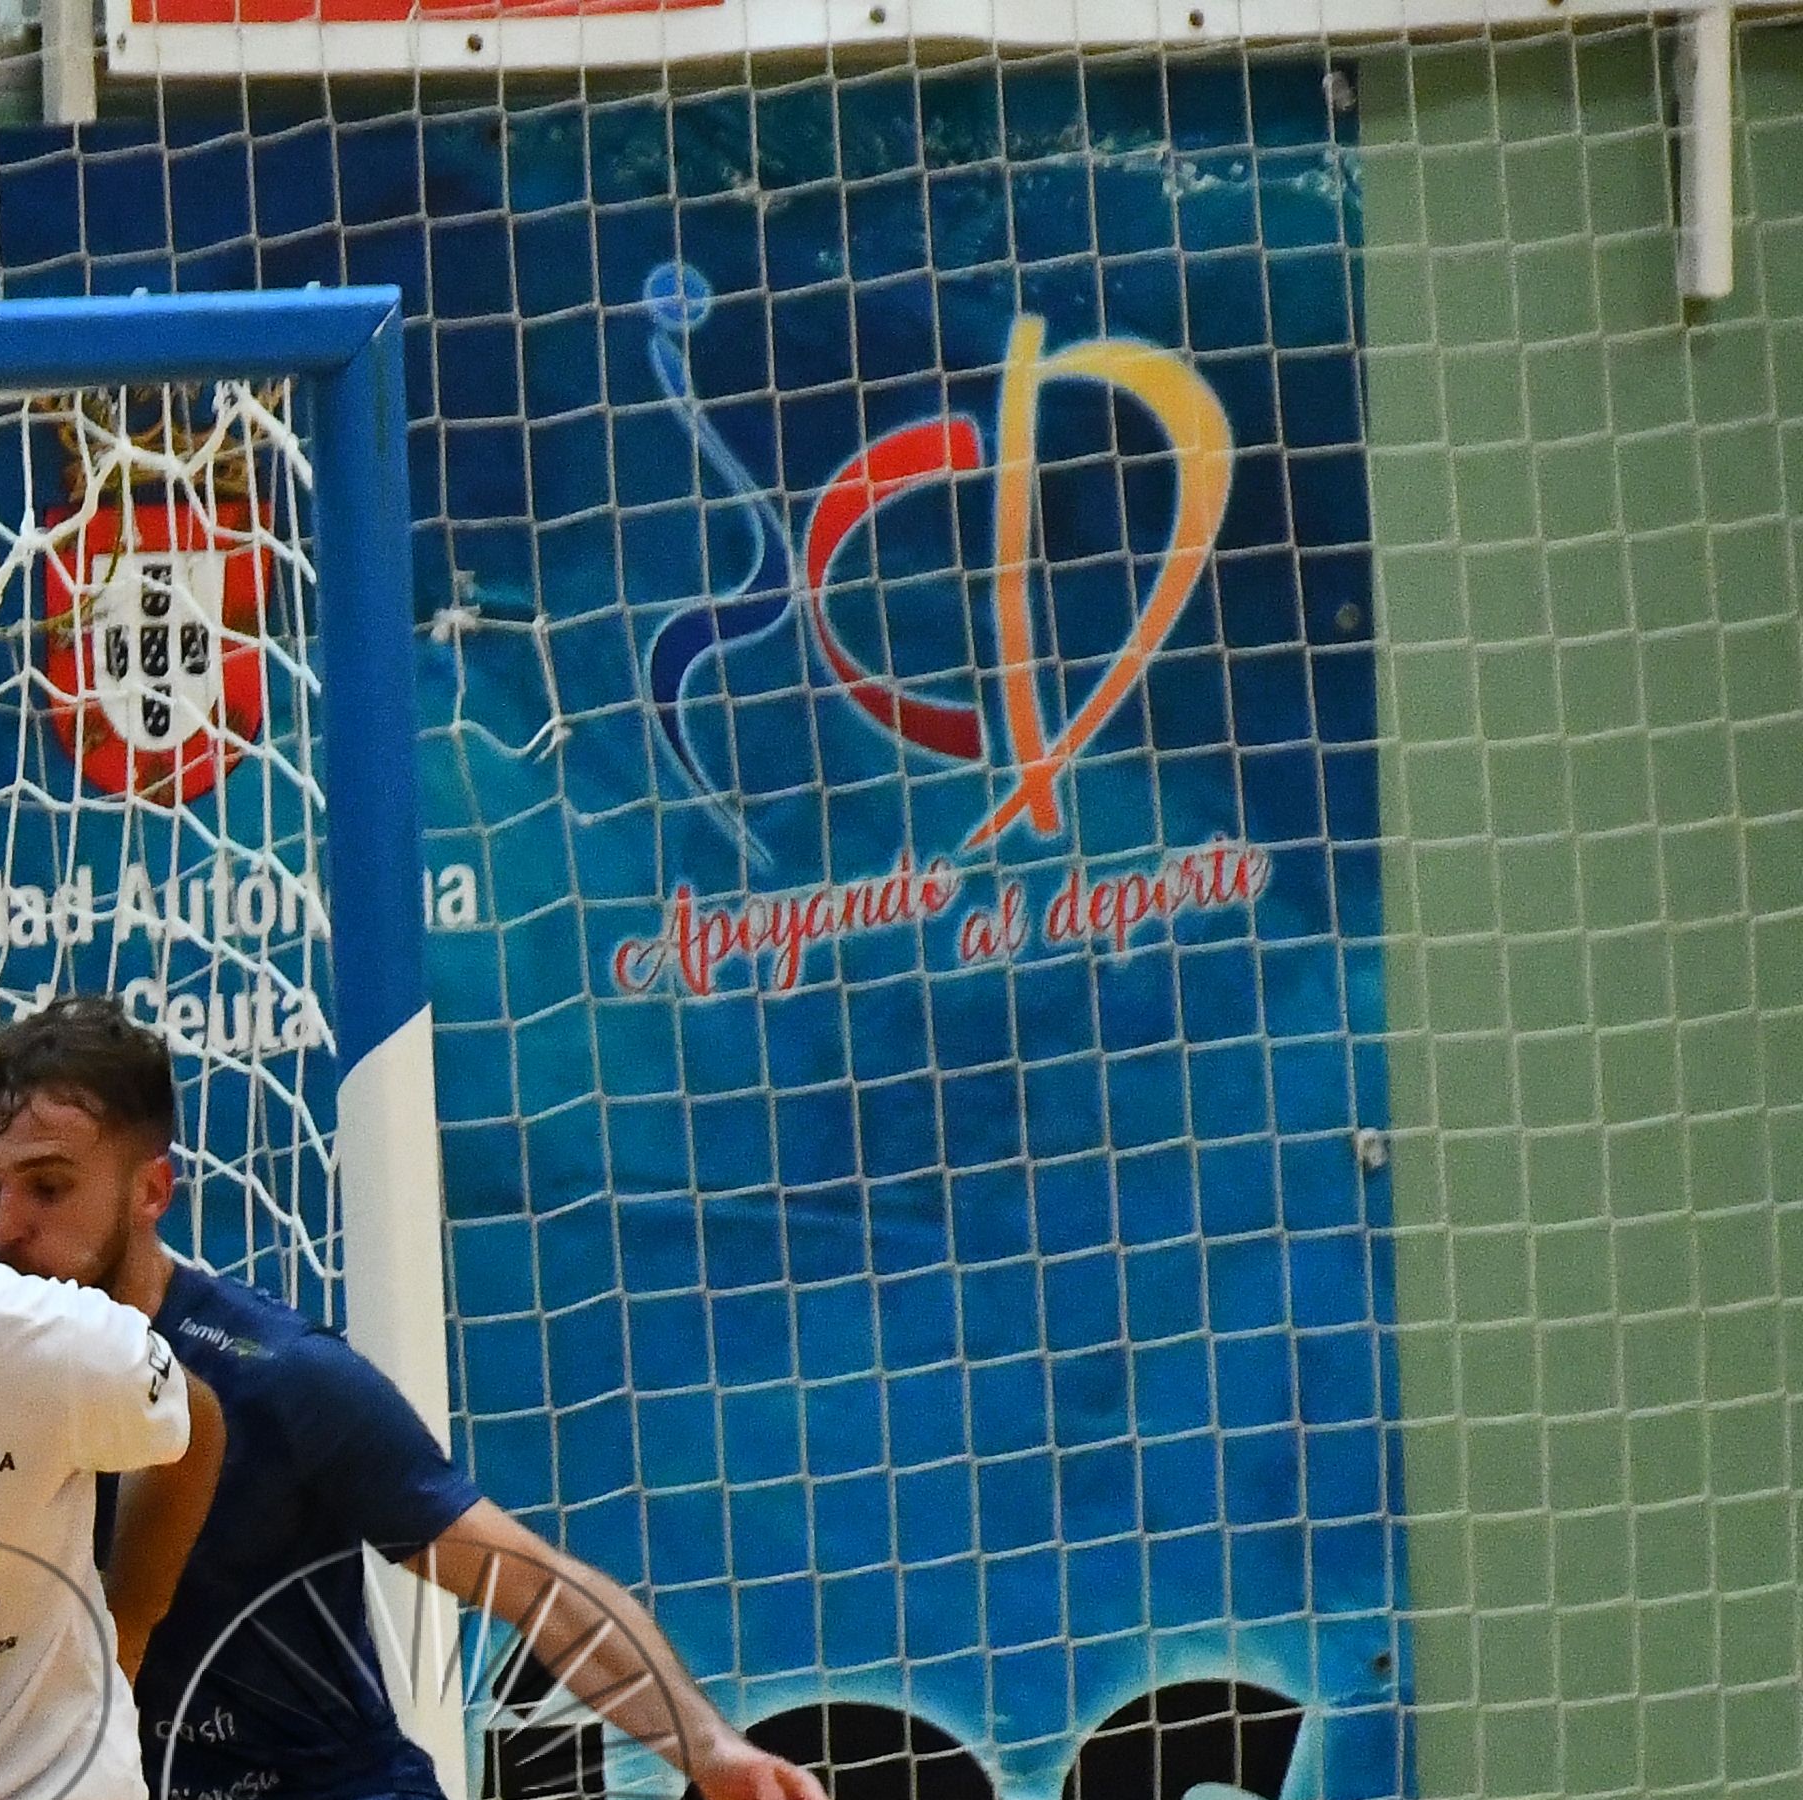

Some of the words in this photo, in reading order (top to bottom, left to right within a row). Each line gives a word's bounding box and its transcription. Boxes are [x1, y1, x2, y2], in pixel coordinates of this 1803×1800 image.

[110, 848, 478, 942] Autóna
[615, 849, 961, 997] Apoyando
[960, 878, 1027, 962] al
[1046, 833, 1273, 960] deporte
[122, 977, 323, 1054] Ceuta
[178, 1316, 235, 1352] family
